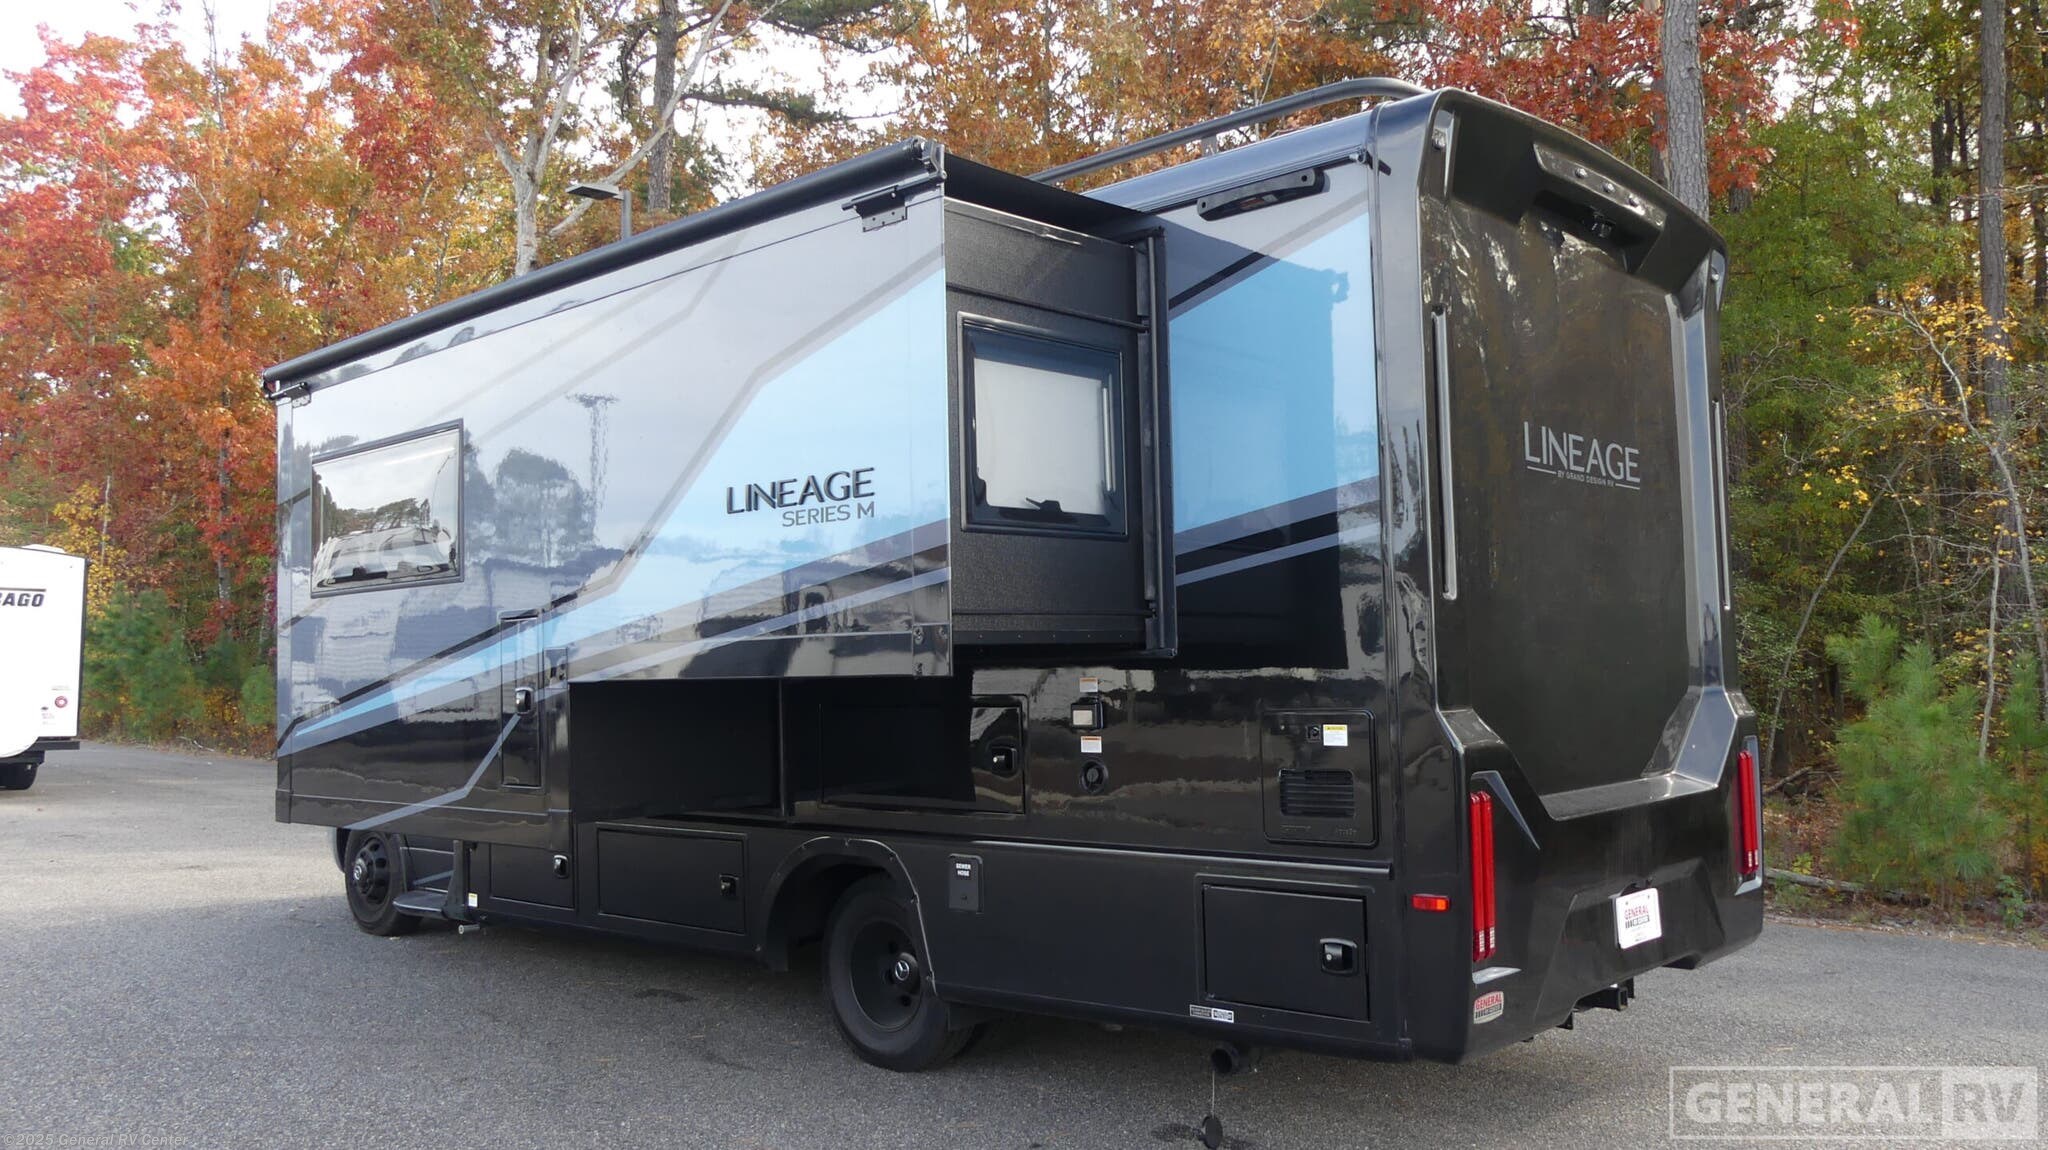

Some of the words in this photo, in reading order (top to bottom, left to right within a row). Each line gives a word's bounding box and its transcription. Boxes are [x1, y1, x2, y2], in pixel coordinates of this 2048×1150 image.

[1523, 421, 1640, 483] LINEAGE
[727, 467, 875, 514] LINEAGE
[782, 505, 851, 527] SERIES
[857, 502, 875, 519] M
[1624, 905, 1649, 920] GENERAL
[1475, 993, 1502, 1010] GENERAL
